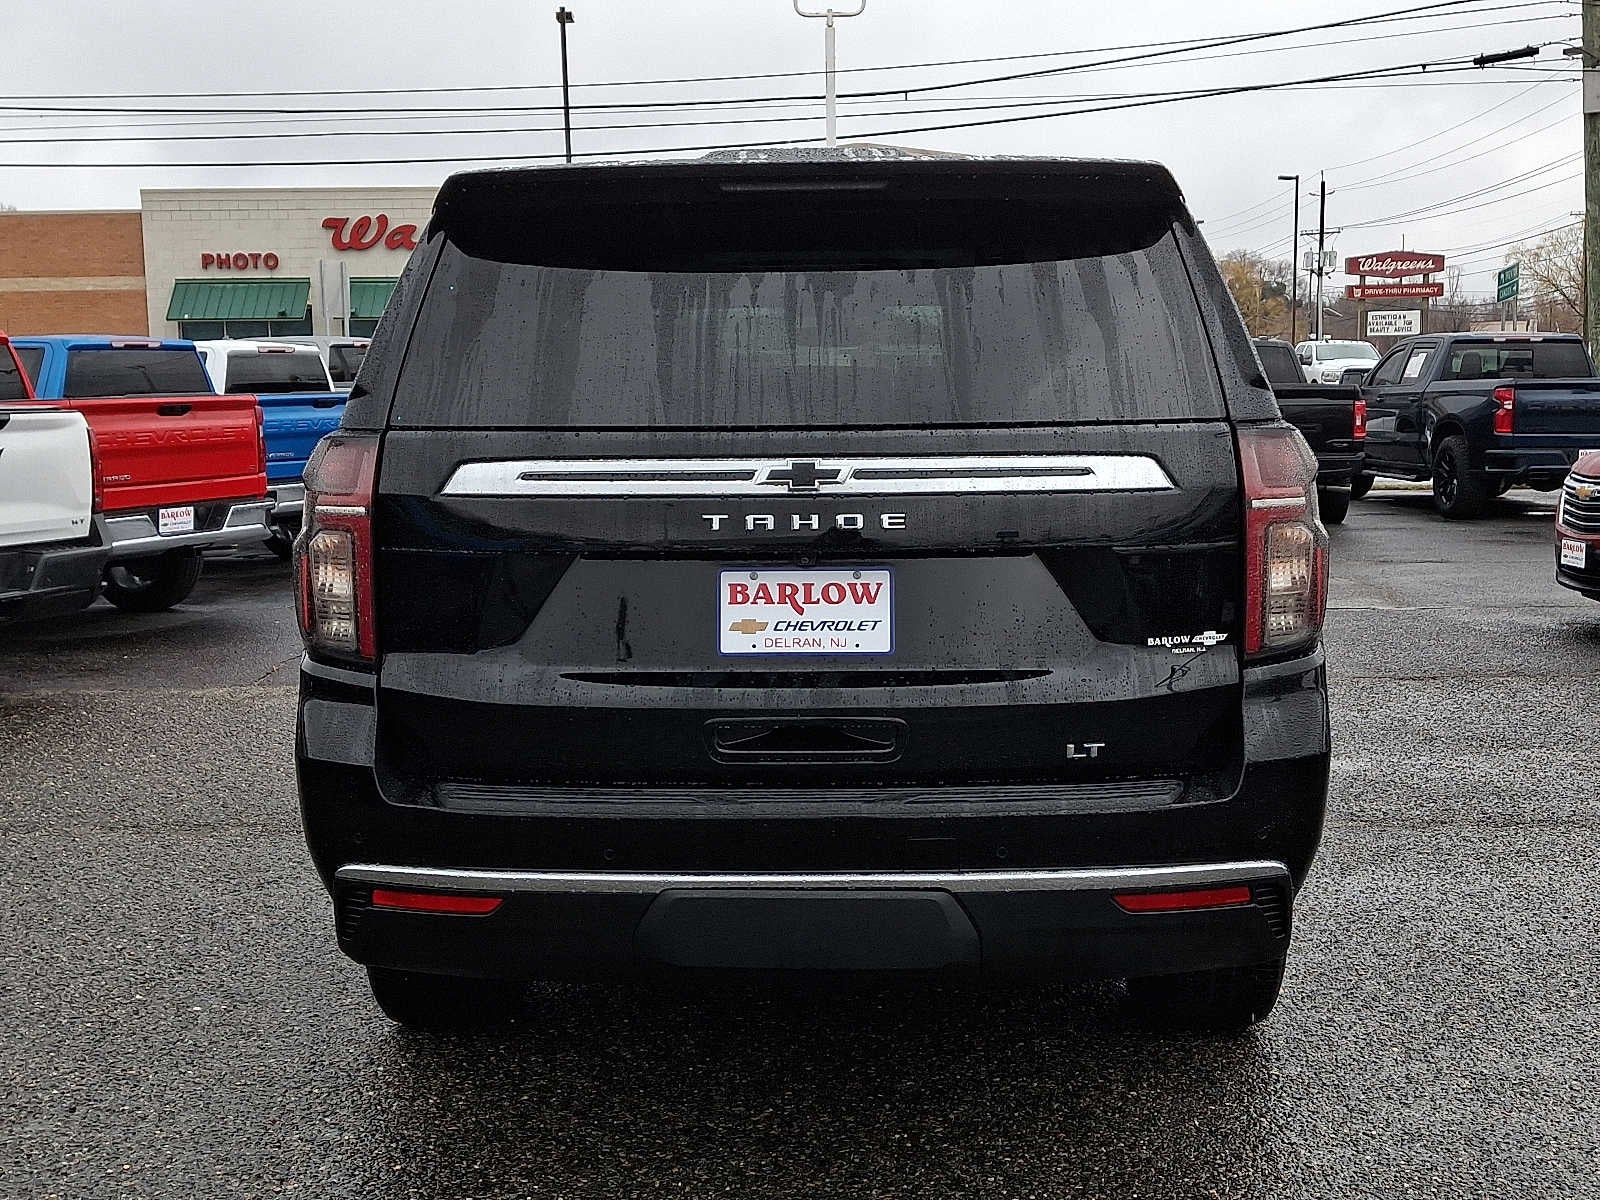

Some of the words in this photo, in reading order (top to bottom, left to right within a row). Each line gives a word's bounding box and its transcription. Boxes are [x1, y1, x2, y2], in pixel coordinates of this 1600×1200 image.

[201, 252, 279, 270] PHOTO
[1358, 257, 1435, 275] Walgreens
[1364, 287, 1402, 295] DRIVE-THRU
[1403, 286, 1439, 294] PHARMACY
[161, 510, 192, 520] BARLOW
[702, 513, 907, 531] TAHOE
[1563, 542, 1584, 554] BARLOW
[728, 582, 883, 616] BARLOW
[773, 620, 882, 632] CHEVROLET
[764, 637, 825, 650] DELRAN,
[830, 637, 848, 648] NJ
[1147, 635, 1190, 647] BARLOW
[1066, 743, 1105, 758] LT
